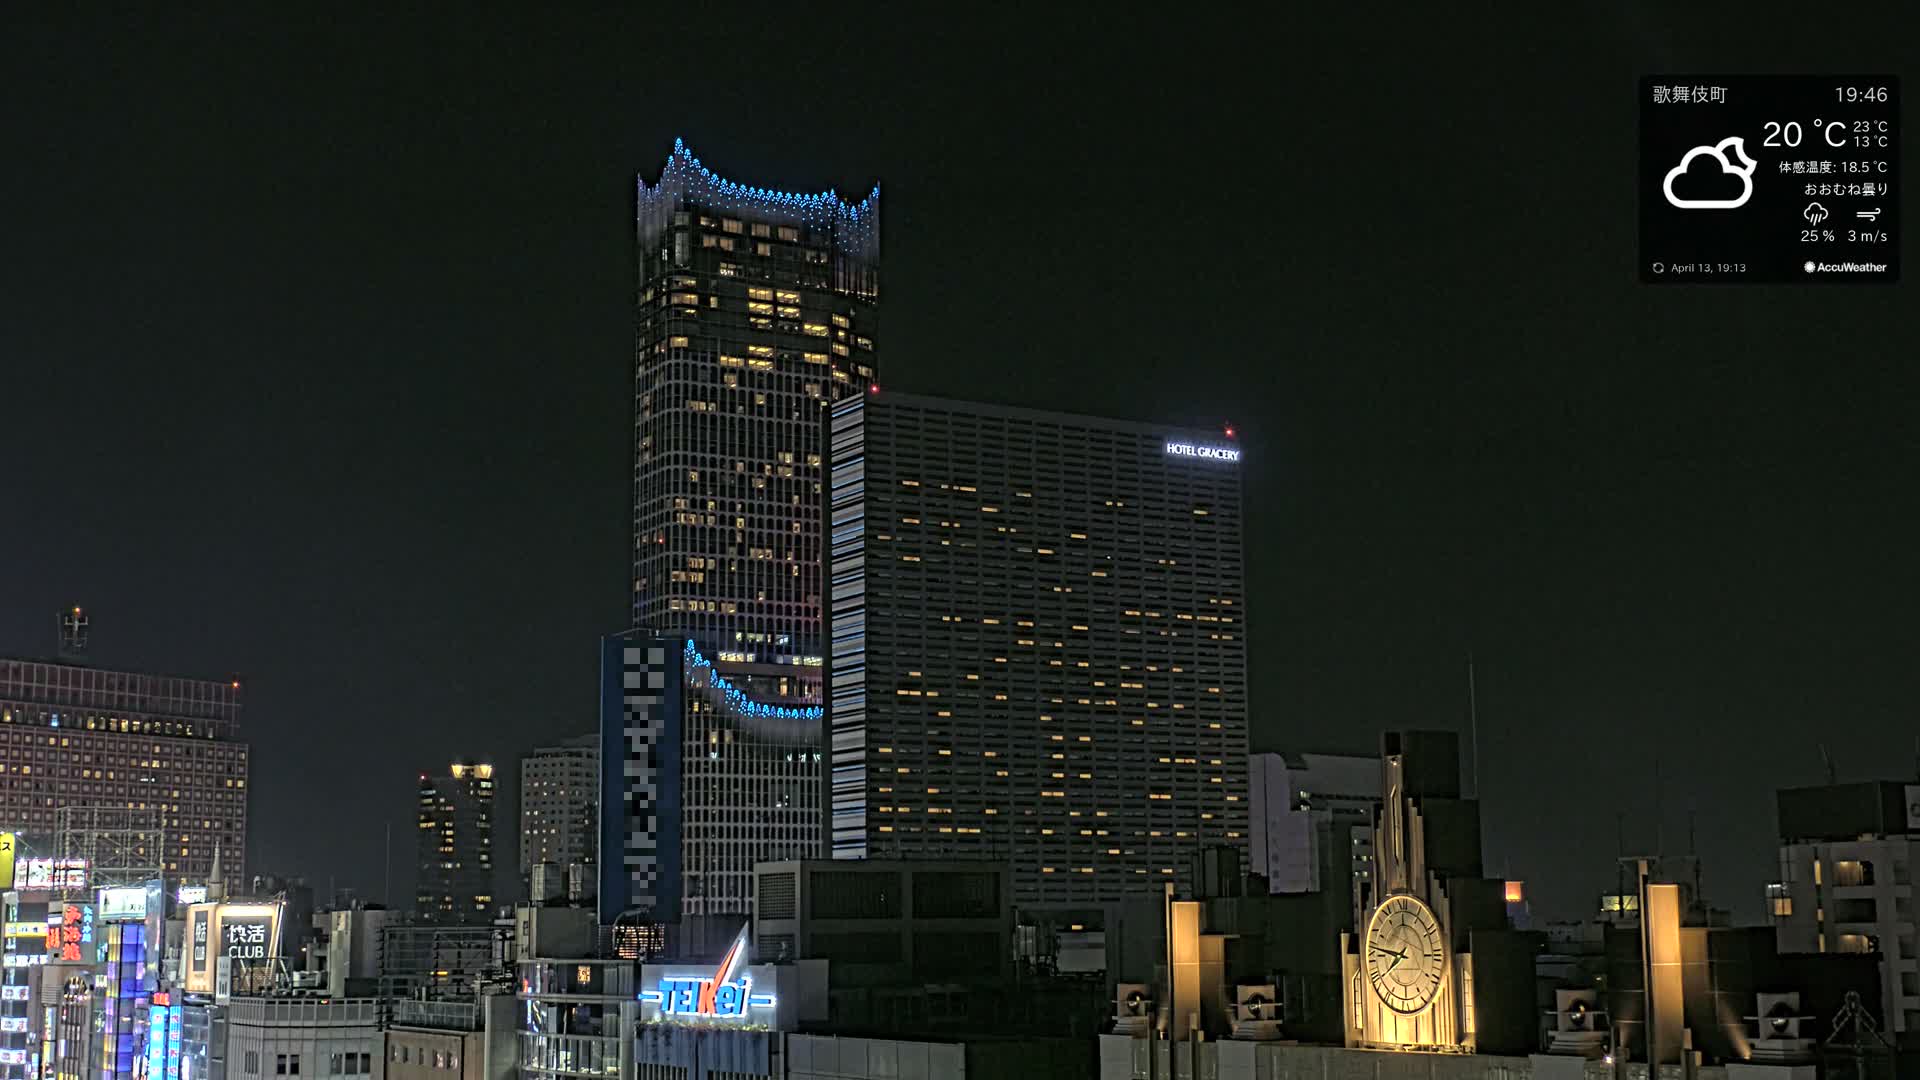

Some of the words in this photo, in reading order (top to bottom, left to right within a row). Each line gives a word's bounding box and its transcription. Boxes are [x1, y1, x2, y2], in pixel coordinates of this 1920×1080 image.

[1166, 443, 1197, 457] HOTEL
[1197, 446, 1239, 461] GRACERY
[228, 924, 265, 943] 快活
[228, 945, 265, 959] CLUB
